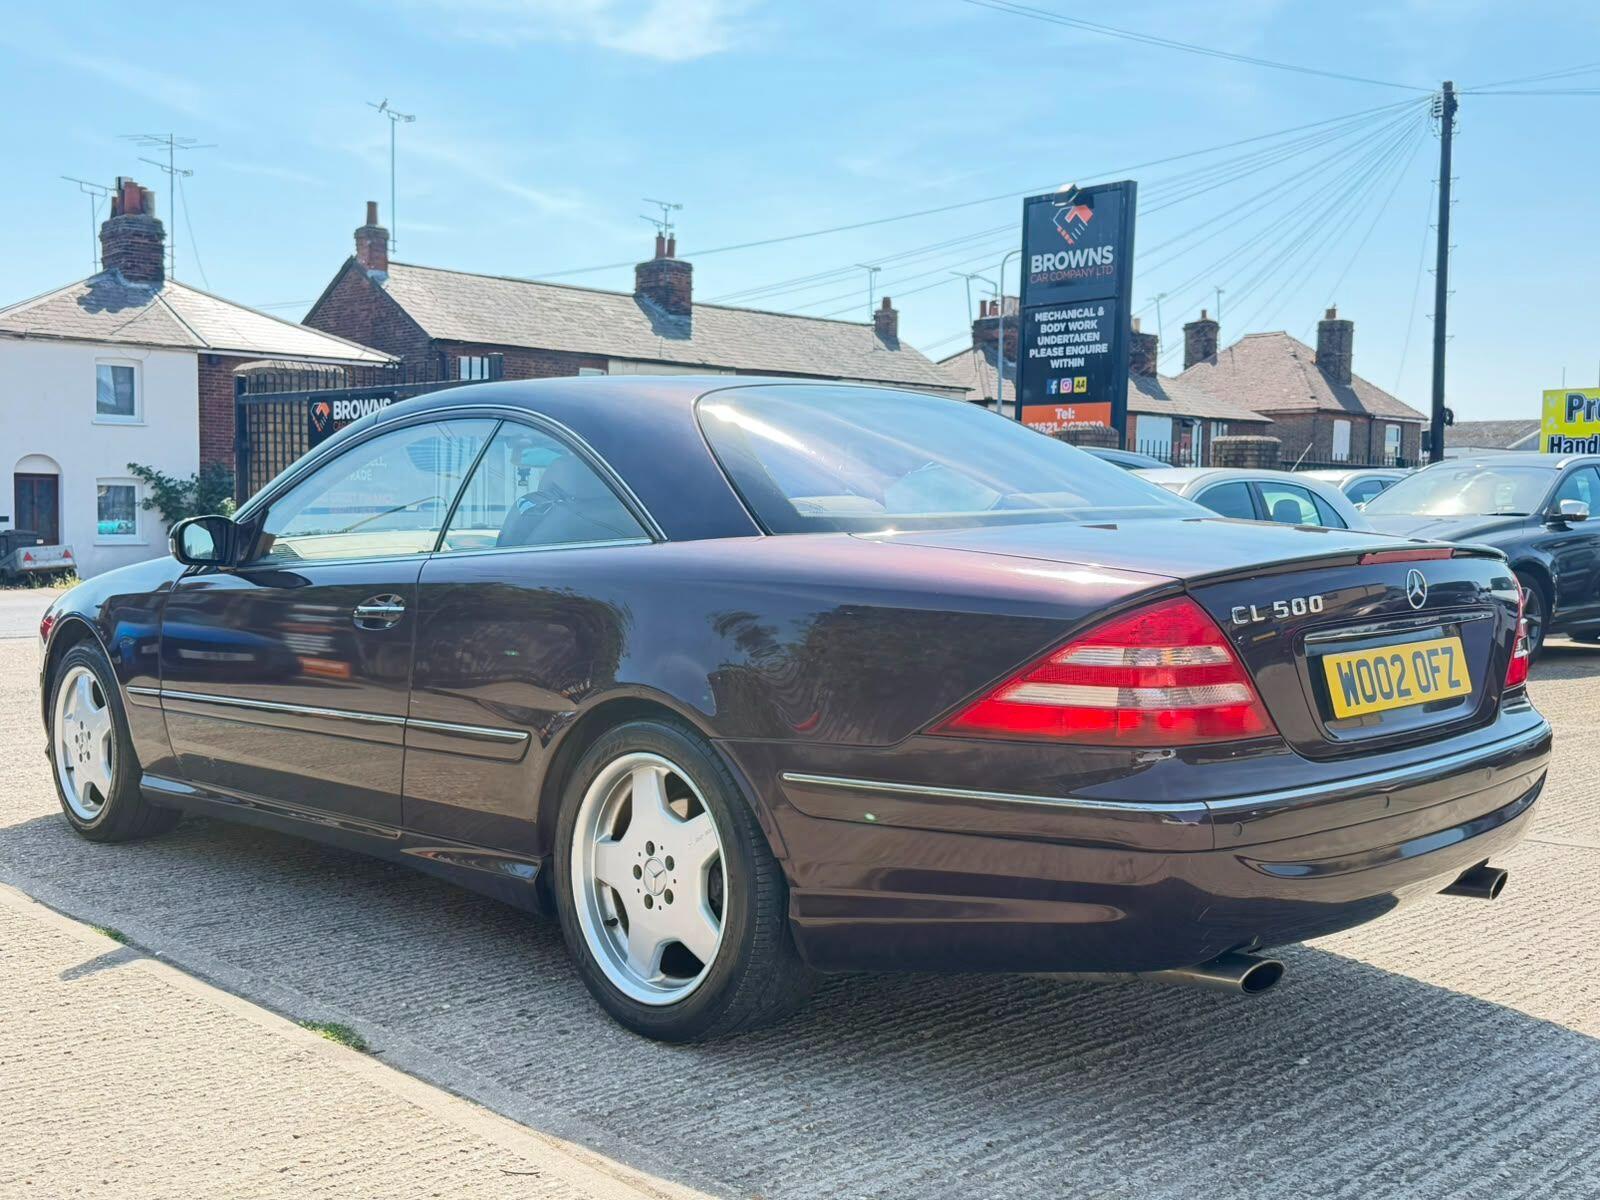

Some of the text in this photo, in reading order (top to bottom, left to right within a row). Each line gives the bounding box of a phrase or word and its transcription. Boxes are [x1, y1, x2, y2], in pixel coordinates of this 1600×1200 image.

[1031, 245, 1114, 274] BROWNS
[1030, 265, 1113, 284] CAR COMPANY LTD
[1035, 306, 1105, 322] MECHANICAL &
[1040, 320, 1098, 334] BODY WORK
[1037, 332, 1101, 346] UNDERTAKEN
[1029, 344, 1108, 358] PLEASE ENQUIRE
[1050, 358, 1085, 369] WITHIN
[1055, 408, 1076, 420] Tel:
[1565, 393, 1600, 423] Pr
[1549, 434, 1600, 455] Hand
[1231, 595, 1324, 625] CL 500
[1411, 646, 1461, 693] OFZ
